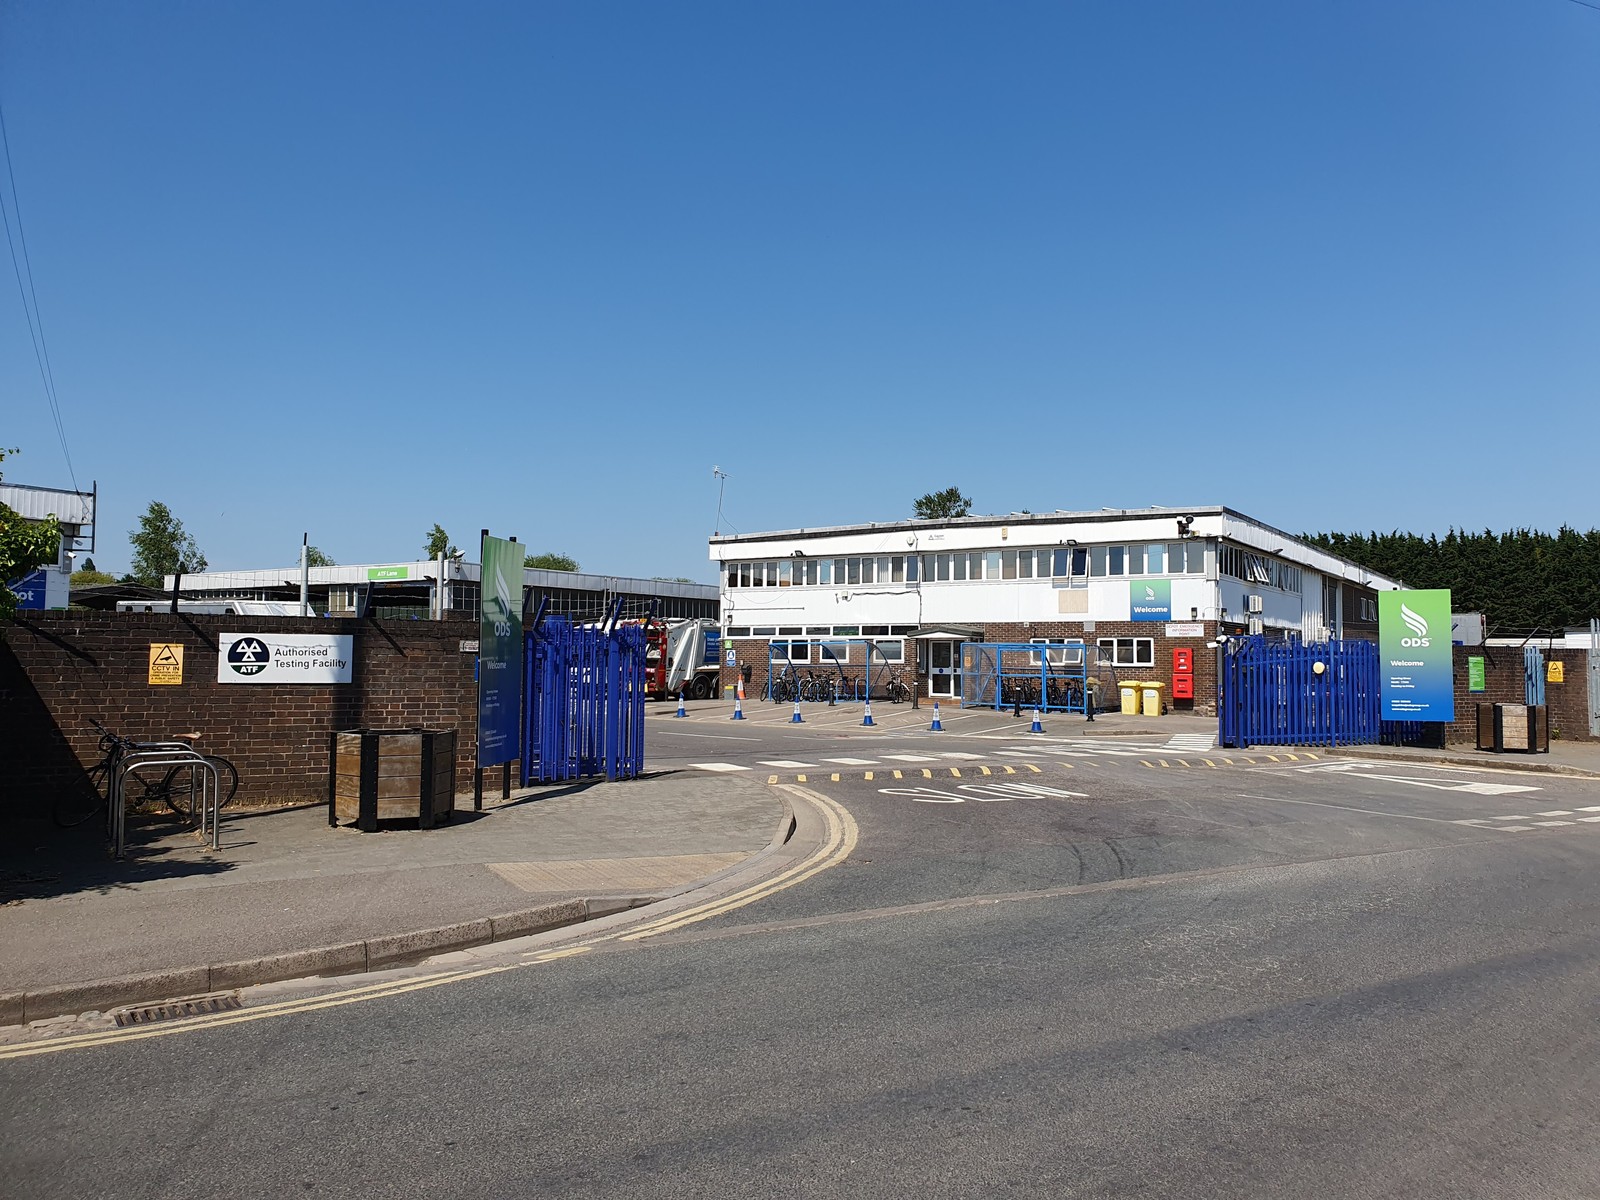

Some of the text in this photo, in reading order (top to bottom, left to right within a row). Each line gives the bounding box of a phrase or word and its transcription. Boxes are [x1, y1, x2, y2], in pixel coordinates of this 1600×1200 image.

[494, 621, 511, 636] ODS
[1401, 637, 1430, 648] ODS
[274, 648, 328, 657] Authorised
[239, 665, 259, 673] ATF
[275, 659, 347, 670] Testing Facility
[486, 660, 507, 670] Welcome
[877, 782, 1090, 804] SLOW
